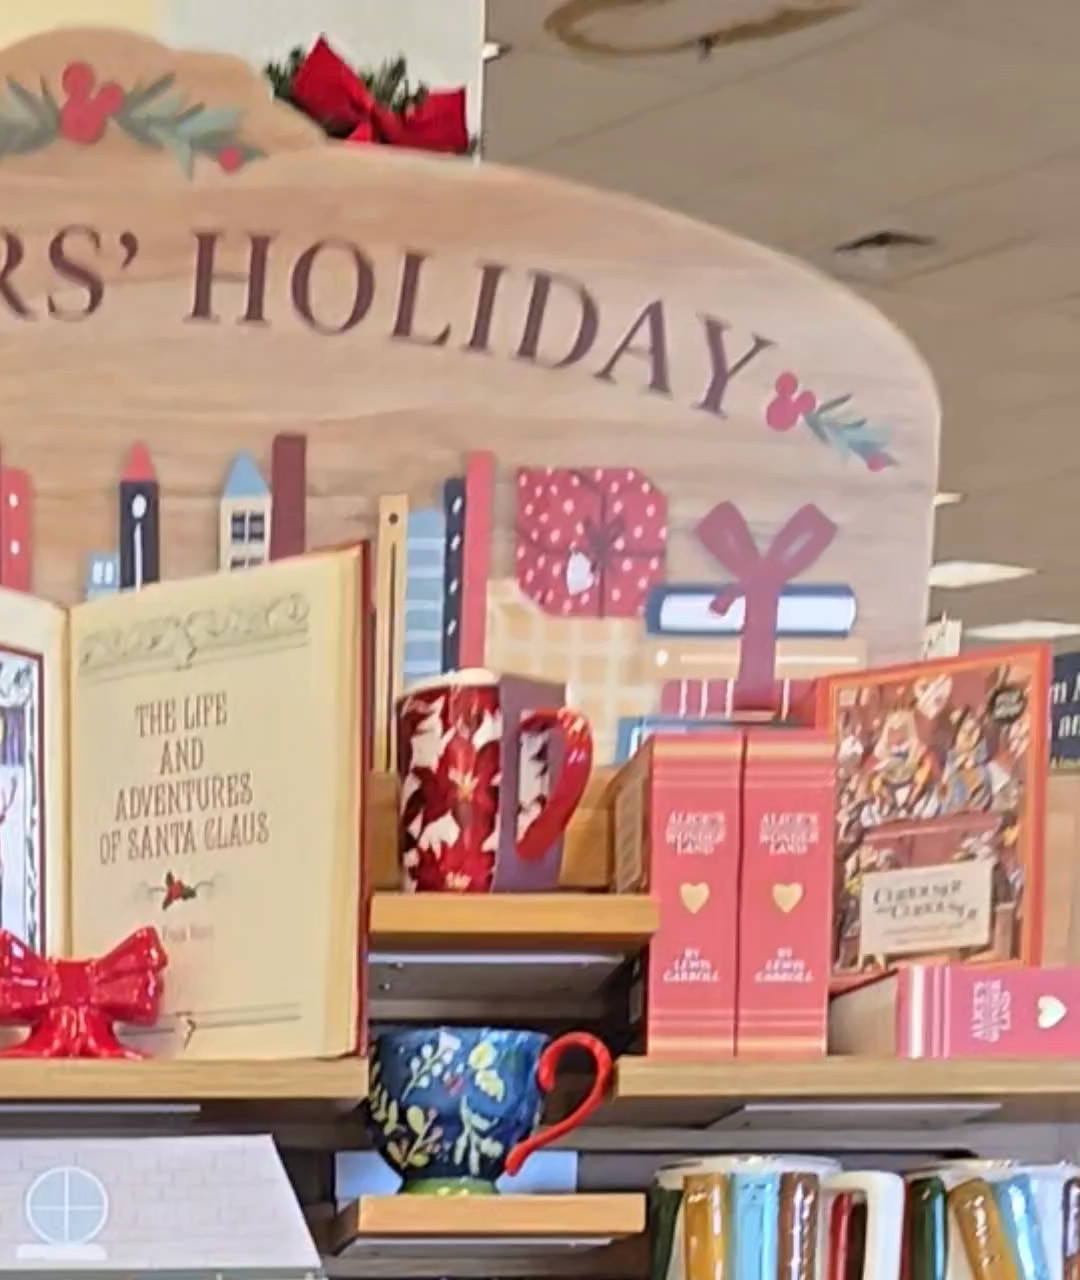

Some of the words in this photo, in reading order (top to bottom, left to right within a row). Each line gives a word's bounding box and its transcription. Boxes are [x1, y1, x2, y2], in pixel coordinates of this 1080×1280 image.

[182, 230, 776, 419] HOLIDAY
[135, 697, 177, 737] THE
[184, 691, 228, 730] LIFE
[160, 737, 205, 775] AND
[115, 772, 253, 821] ADVENTURES
[100, 830, 122, 864] OF
[128, 819, 196, 861] SANTA
[204, 811, 270, 851] CLAUS
